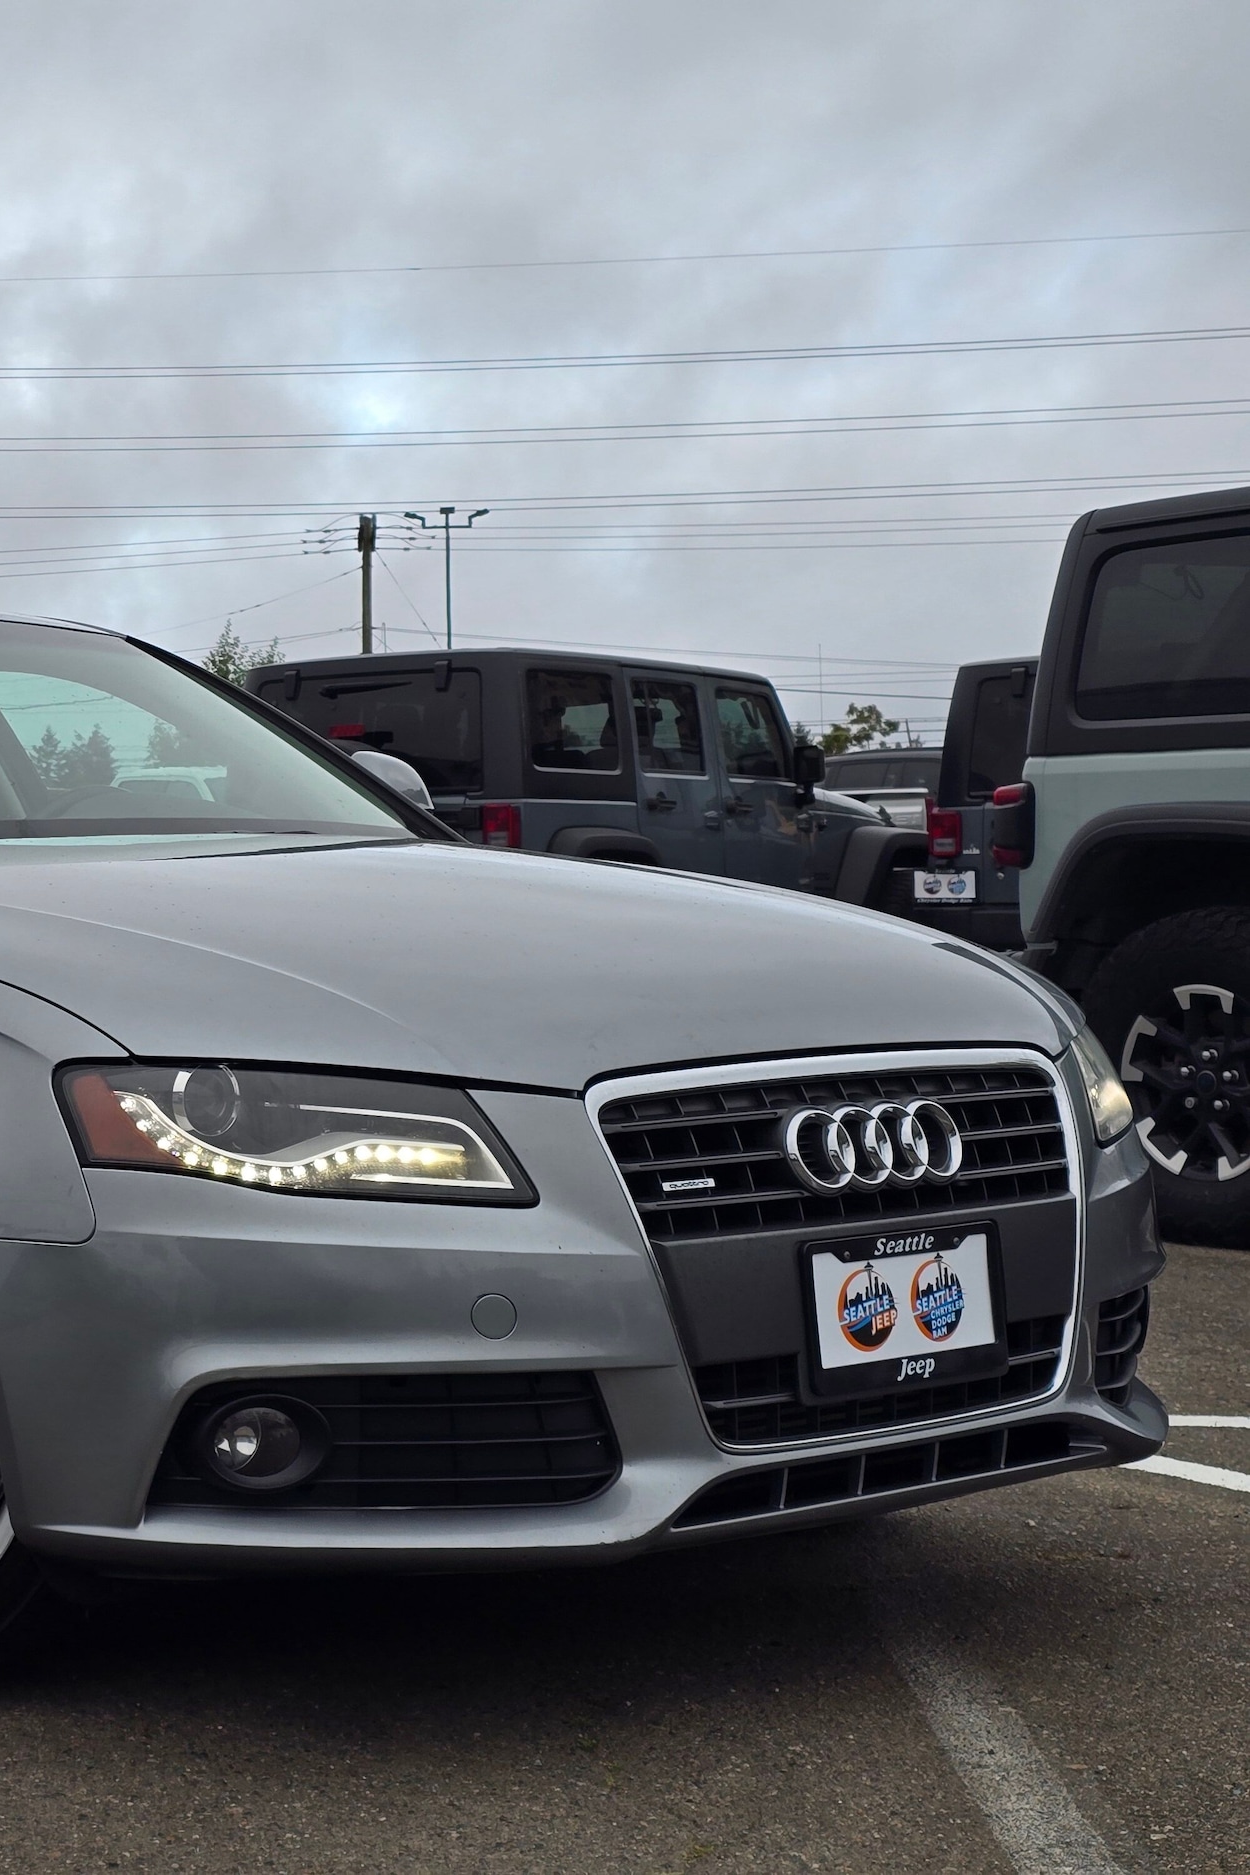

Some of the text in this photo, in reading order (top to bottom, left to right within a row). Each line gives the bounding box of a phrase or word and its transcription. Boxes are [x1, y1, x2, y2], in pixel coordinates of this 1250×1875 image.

[669, 1180, 709, 1189] quattro
[874, 1233, 935, 1256] Seattle
[842, 1294, 891, 1324] SEATTLE
[915, 1285, 959, 1313] SEATTLE
[930, 1299, 965, 1319] CHRYSLER
[870, 1308, 898, 1336] JEEP
[931, 1312, 956, 1330] DODGE
[932, 1326, 948, 1340] RAM
[897, 1357, 936, 1381] Jeep
